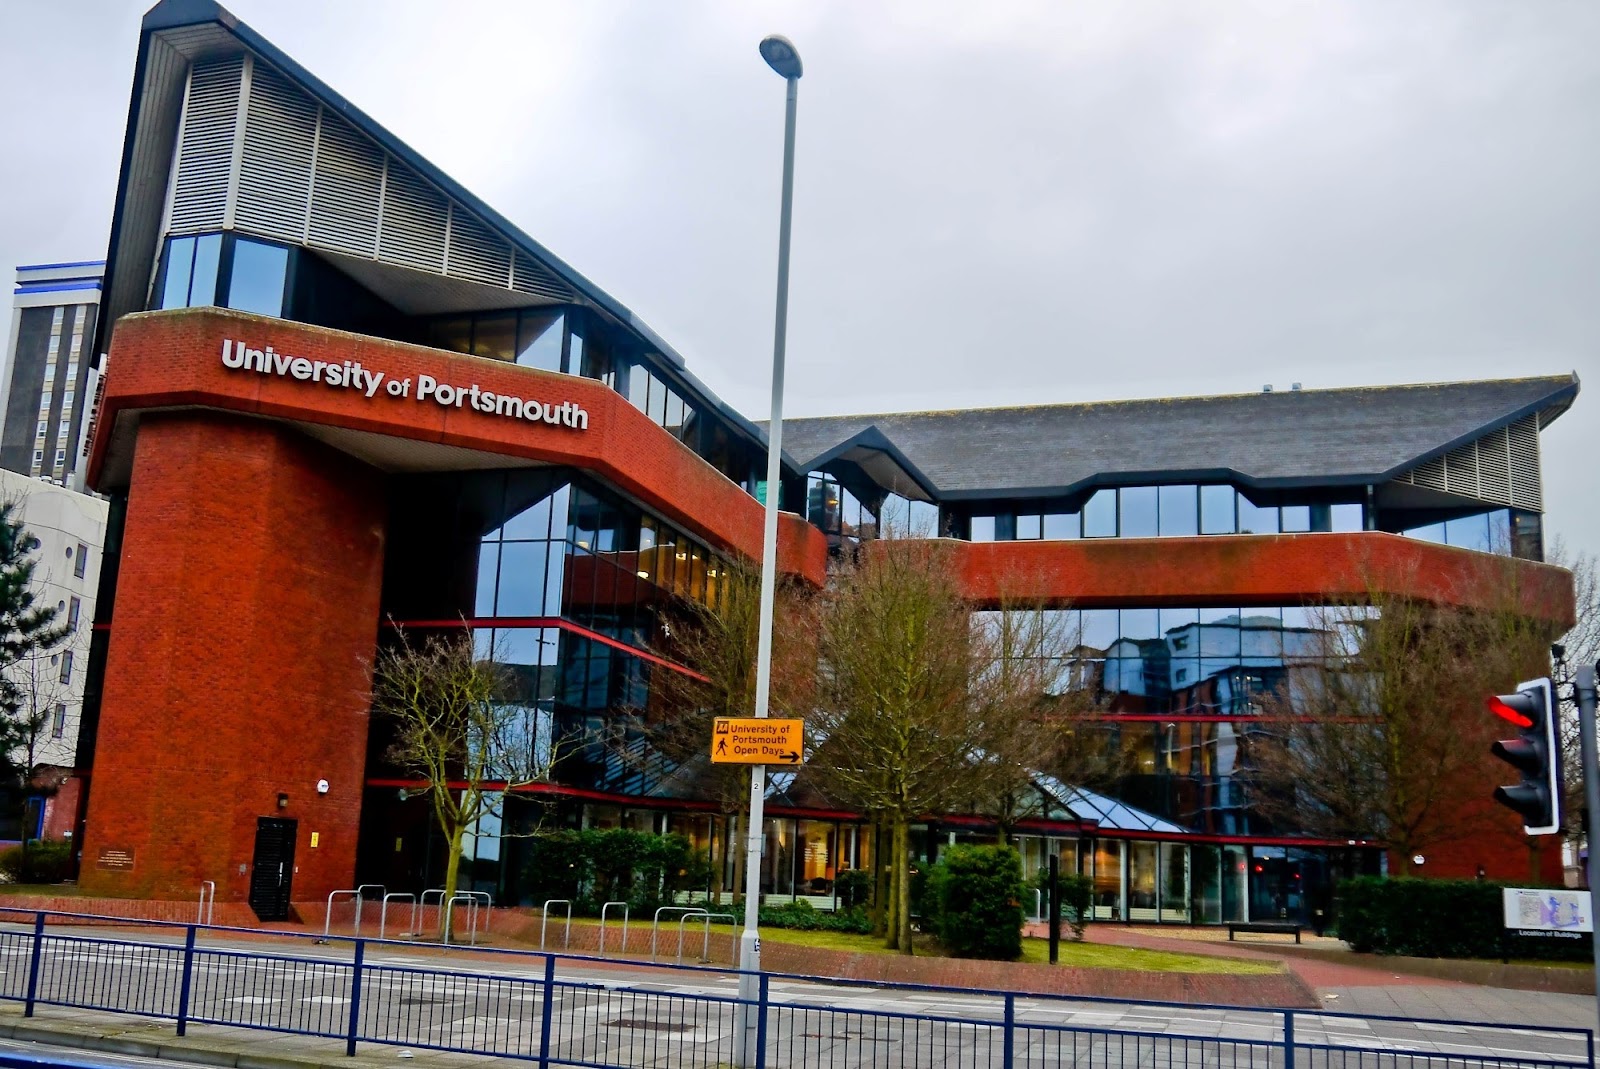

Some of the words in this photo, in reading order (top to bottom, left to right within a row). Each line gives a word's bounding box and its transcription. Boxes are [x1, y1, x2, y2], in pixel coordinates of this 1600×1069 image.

[222, 339, 385, 397] University
[386, 378, 411, 397] of
[416, 374, 589, 430] Portsmouth
[730, 724, 778, 735] University
[781, 725, 790, 733] of
[732, 735, 787, 744] Portsmouth
[734, 745, 758, 755] Open
[762, 746, 785, 755] Days
